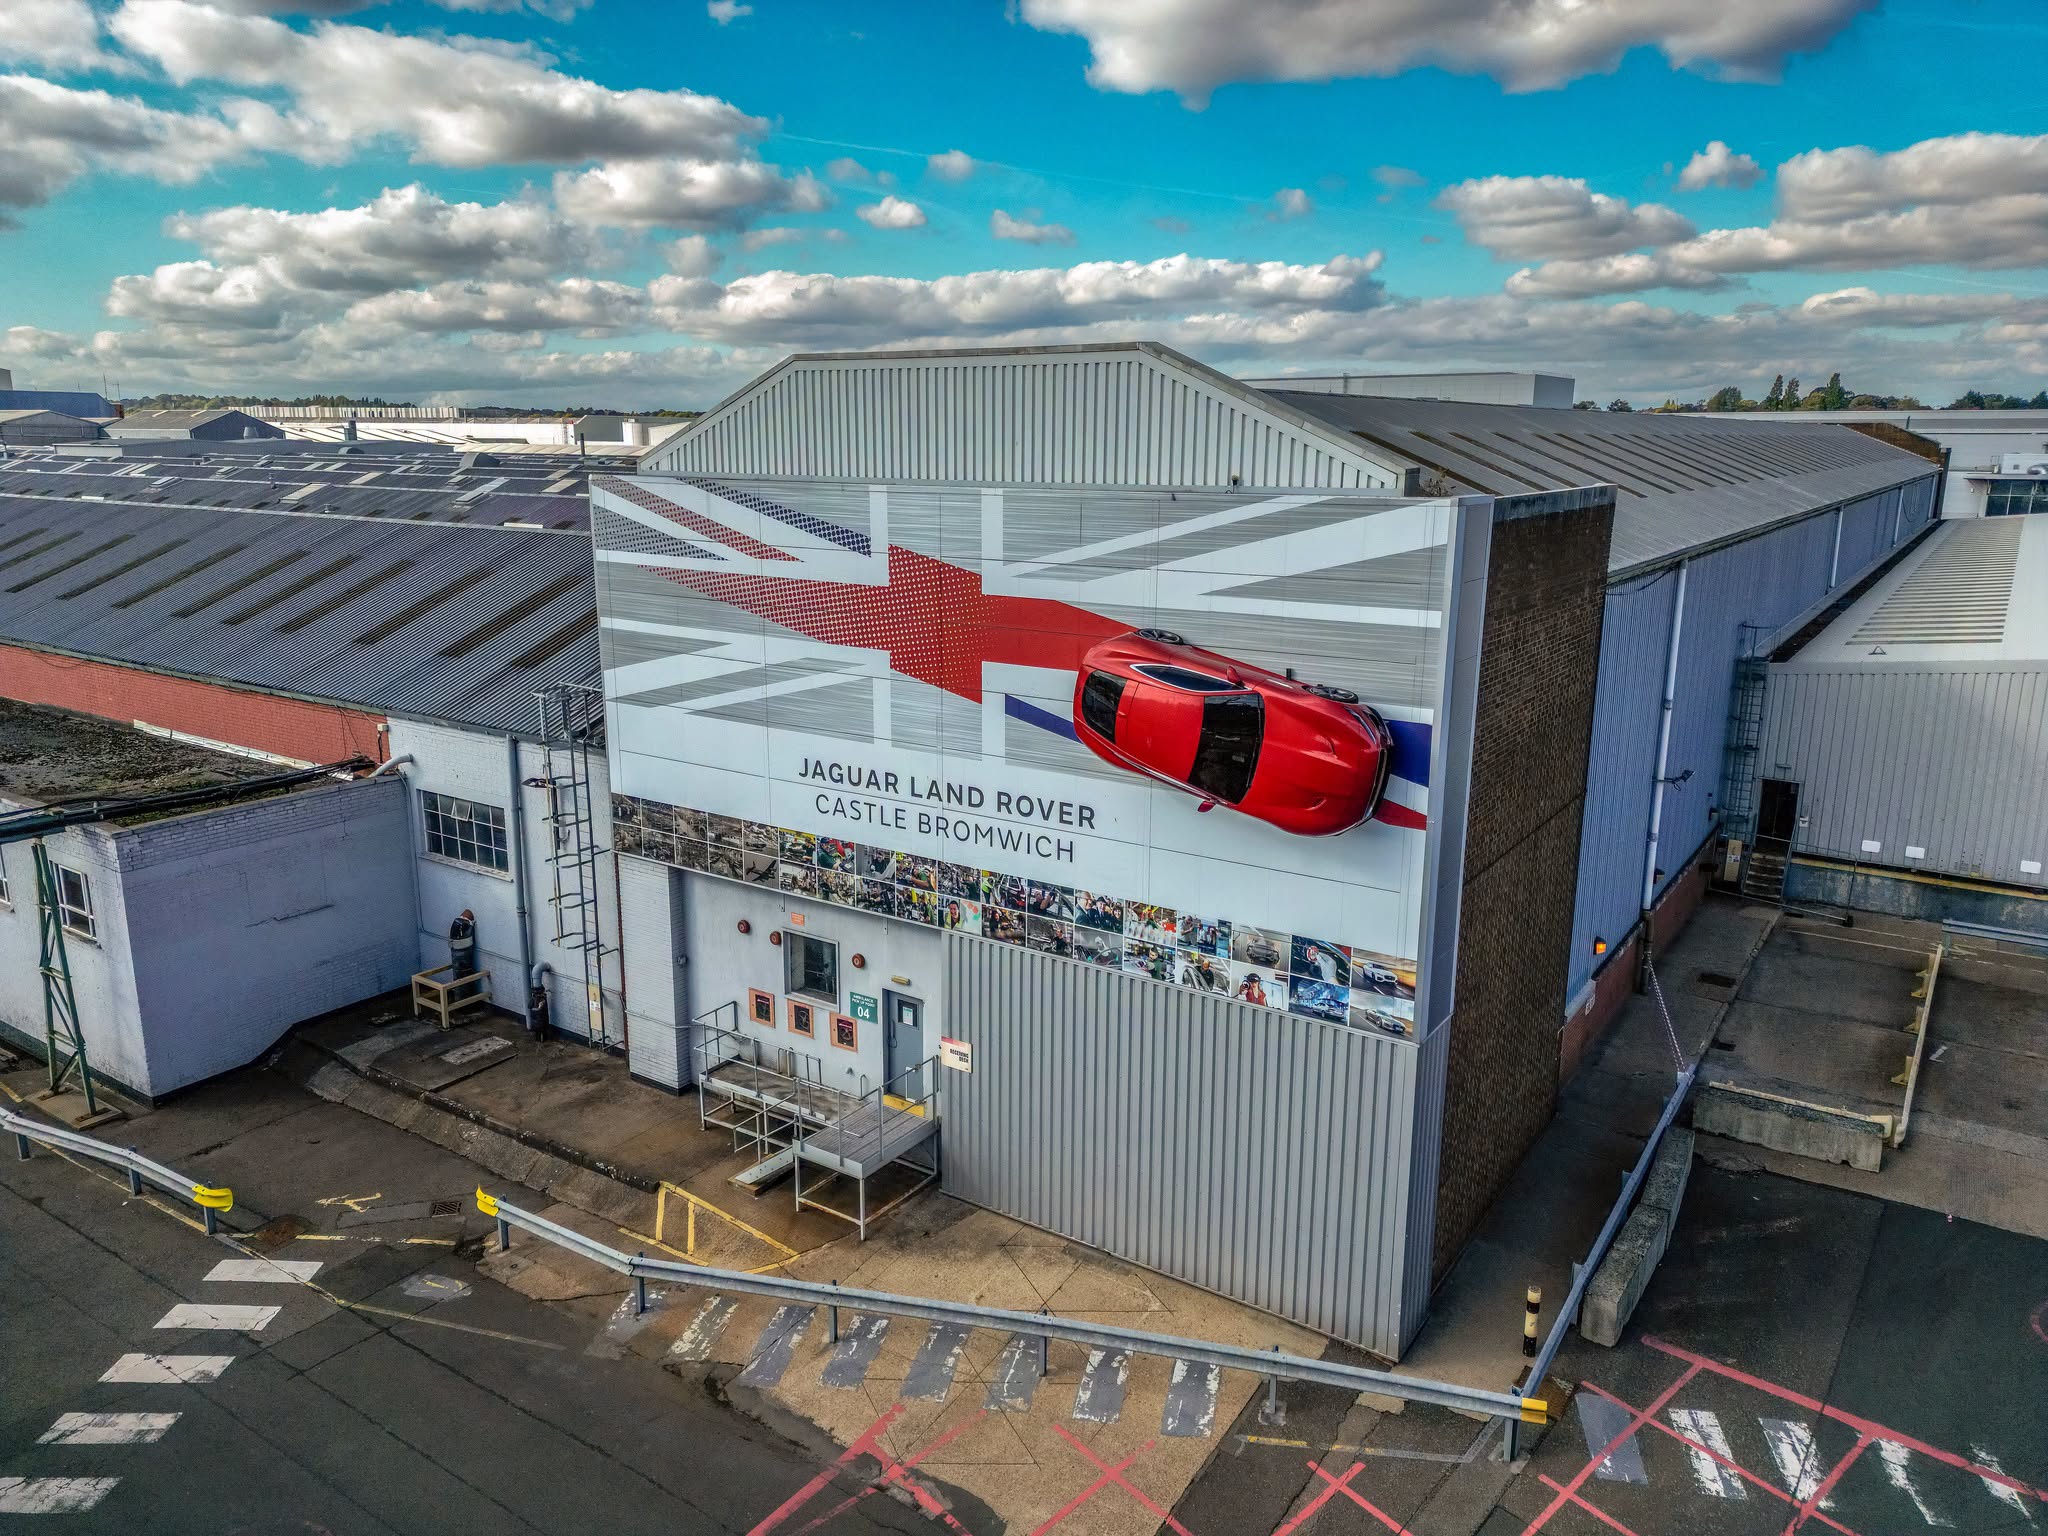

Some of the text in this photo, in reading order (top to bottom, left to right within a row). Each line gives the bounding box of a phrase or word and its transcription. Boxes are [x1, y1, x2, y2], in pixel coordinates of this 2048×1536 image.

[799, 758, 1096, 830] JAGUAR LAND ROVER
[815, 794, 1074, 863] CASTLE BROMWICH
[857, 1006, 869, 1019] 04
